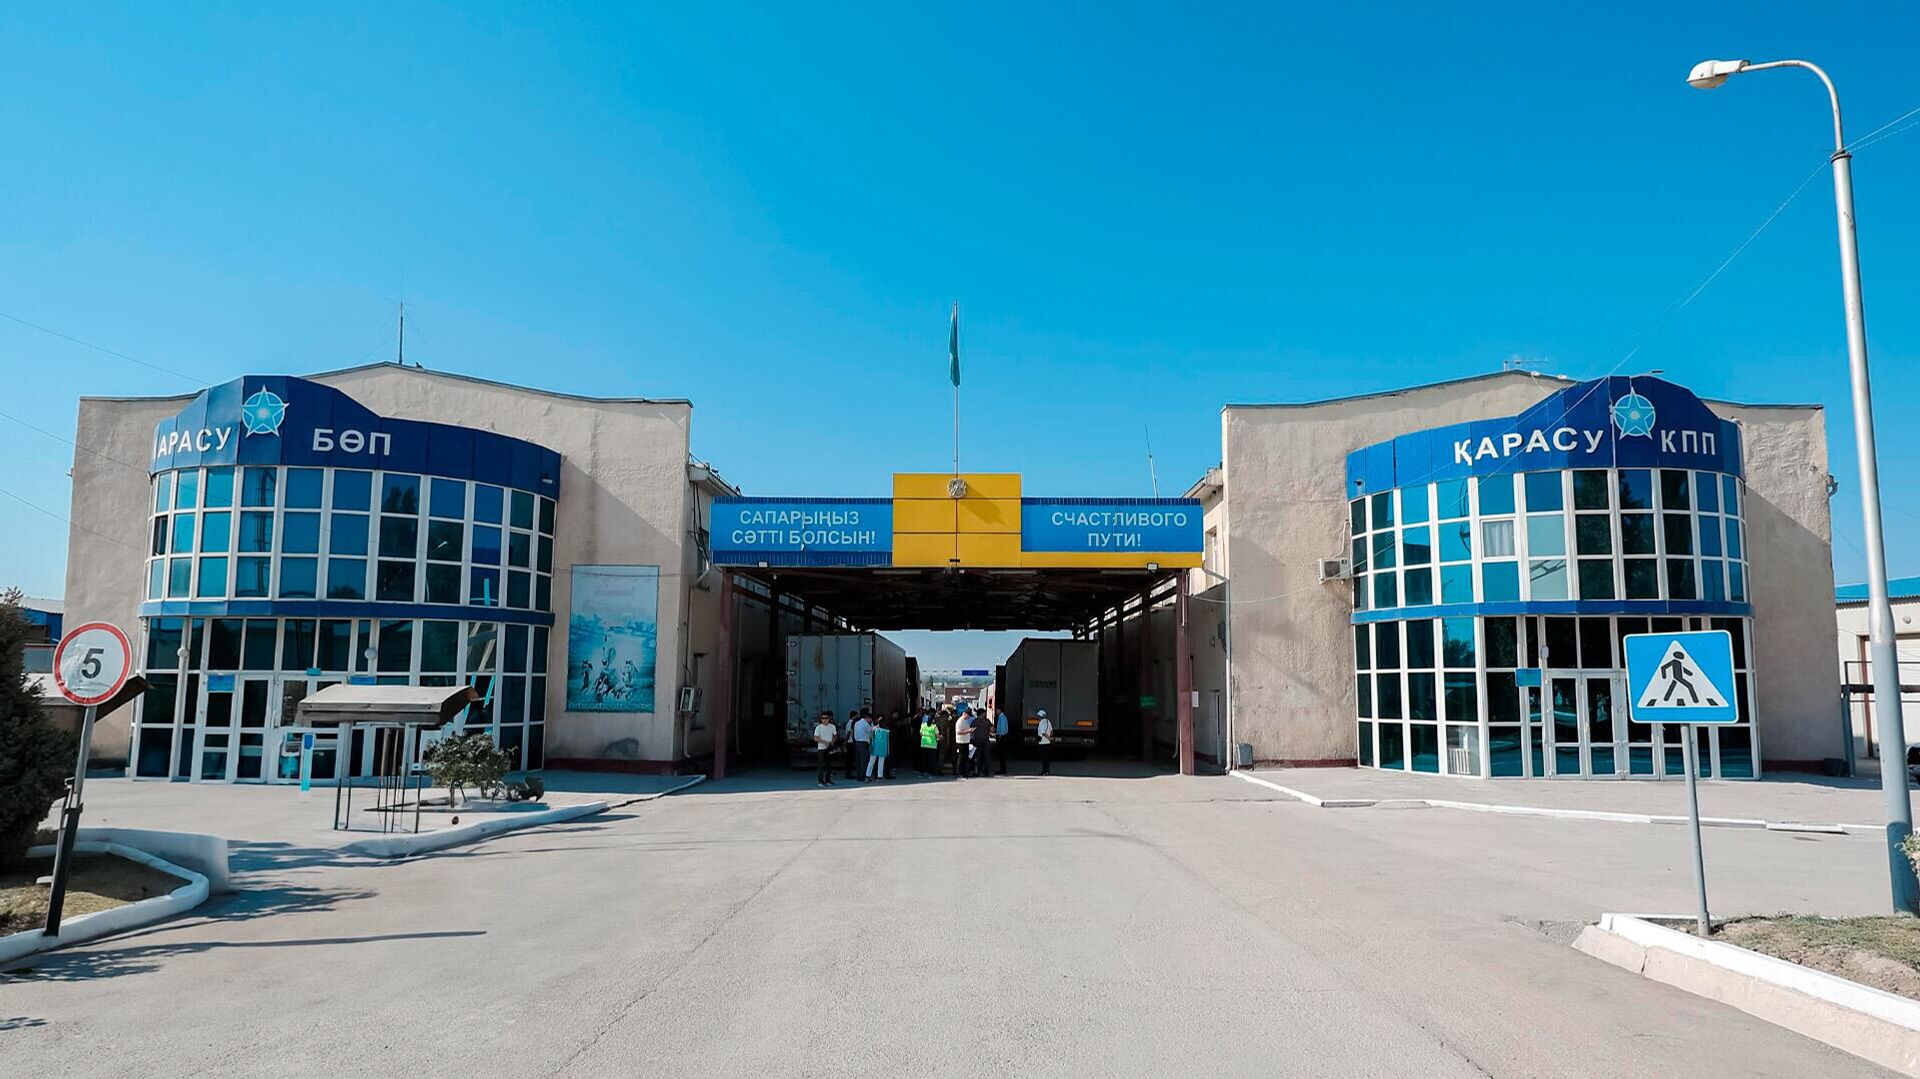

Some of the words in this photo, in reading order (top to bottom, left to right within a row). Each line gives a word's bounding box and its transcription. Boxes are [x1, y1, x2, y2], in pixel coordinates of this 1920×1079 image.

[153, 426, 232, 461] АРАСУ
[312, 428, 392, 456] БӨП
[1454, 426, 1604, 466] ҚАРАСУ
[1660, 429, 1716, 456] КПП
[740, 510, 860, 527] САПАРЫҢЫЗ
[1051, 511, 1188, 527] СЧАСТЛИВОГО
[731, 529, 783, 545] СӘТТІ
[789, 529, 876, 545] БОЛСЫН!
[1087, 532, 1141, 547] ПУТИ!
[81, 647, 105, 679] 5
